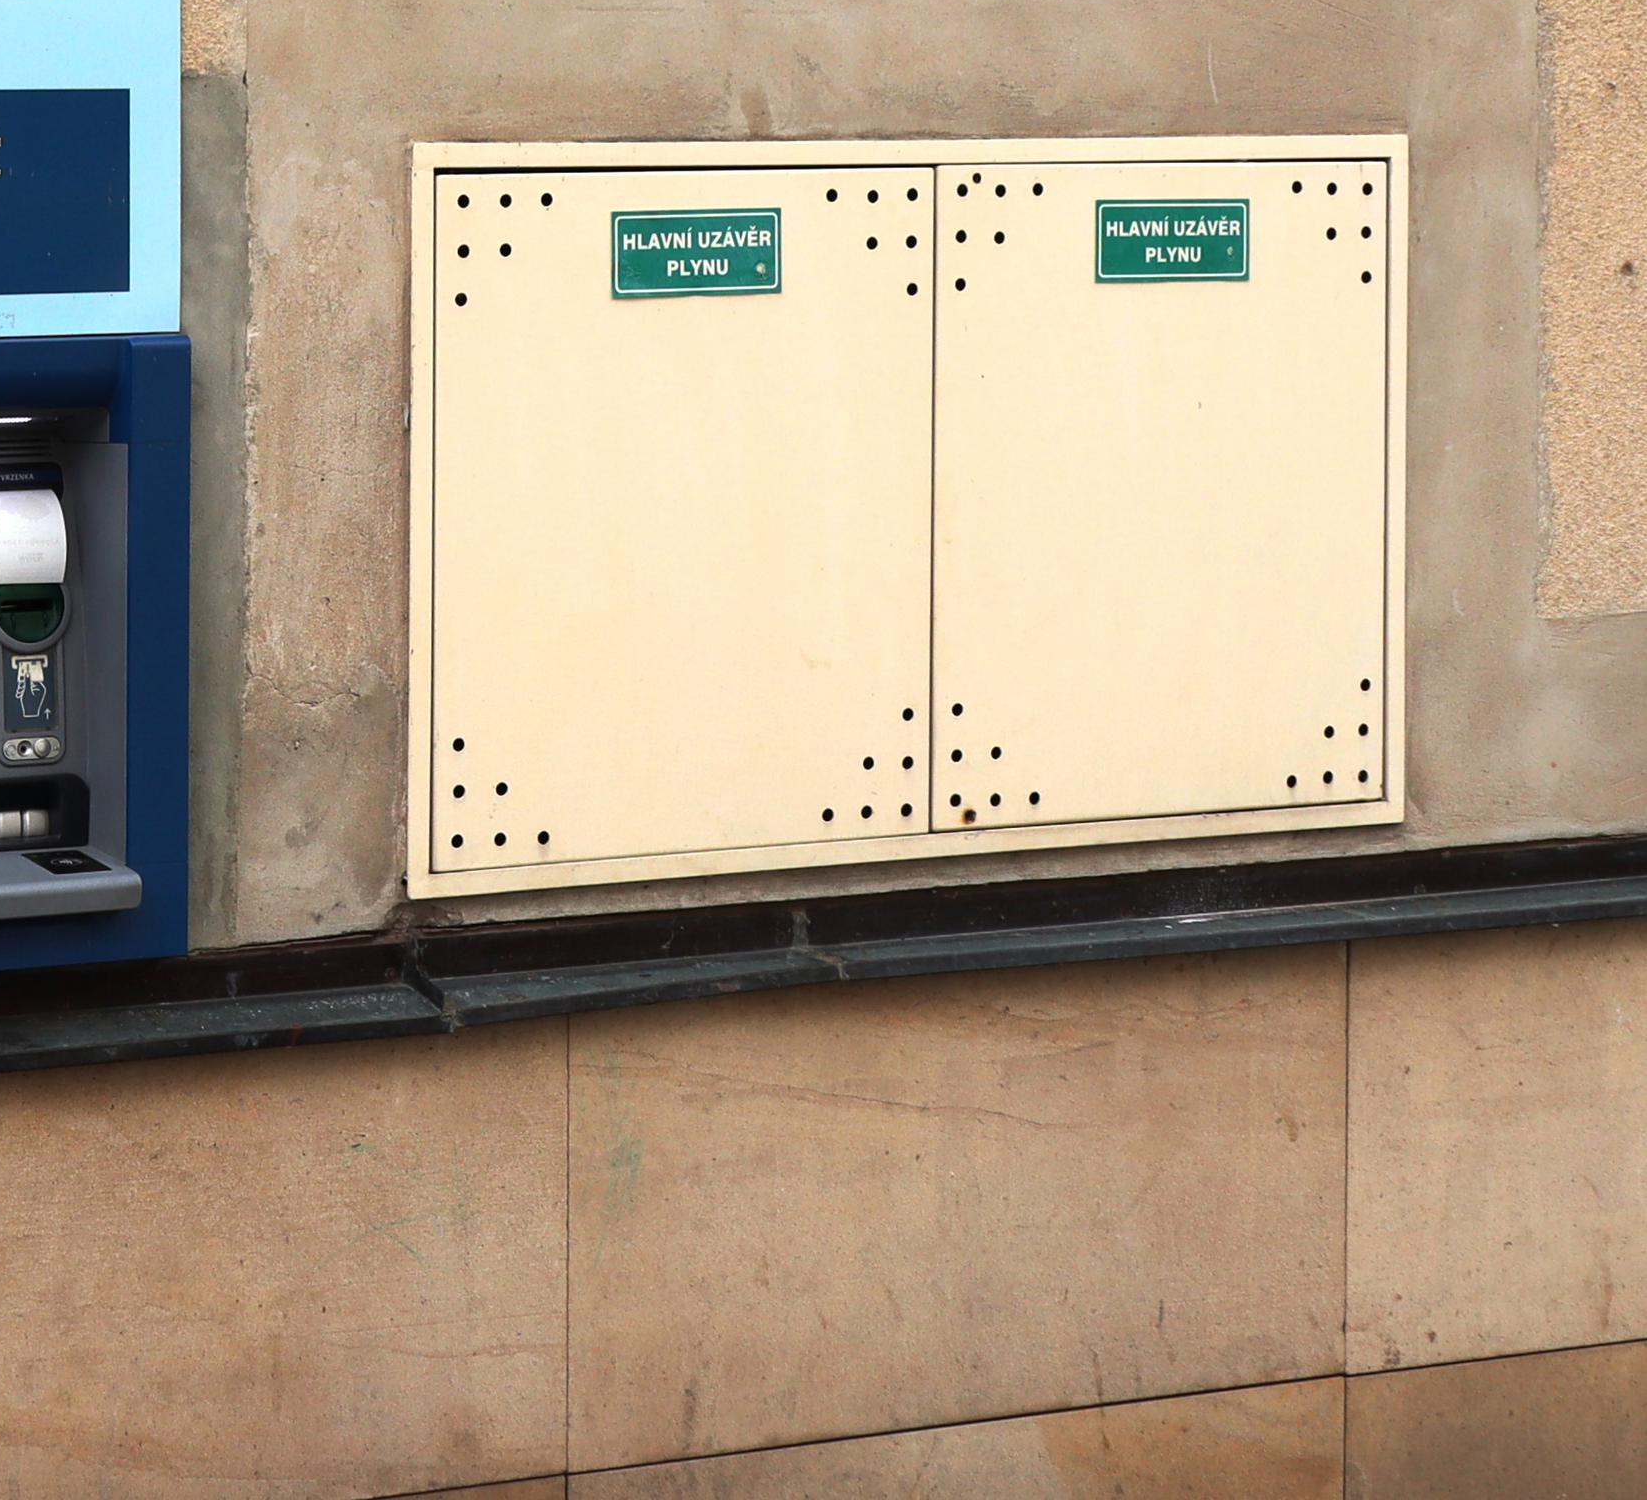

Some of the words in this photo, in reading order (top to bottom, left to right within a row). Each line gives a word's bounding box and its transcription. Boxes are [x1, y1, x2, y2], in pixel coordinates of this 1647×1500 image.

[1106, 215, 1169, 237] HLAVNÍ
[1173, 215, 1241, 237] UZÁVĚR
[622, 227, 692, 250] HLAVNÍ
[698, 225, 772, 249] UZÁVĚR
[1145, 246, 1202, 263] PLYNU
[666, 258, 729, 277] PLYNU
